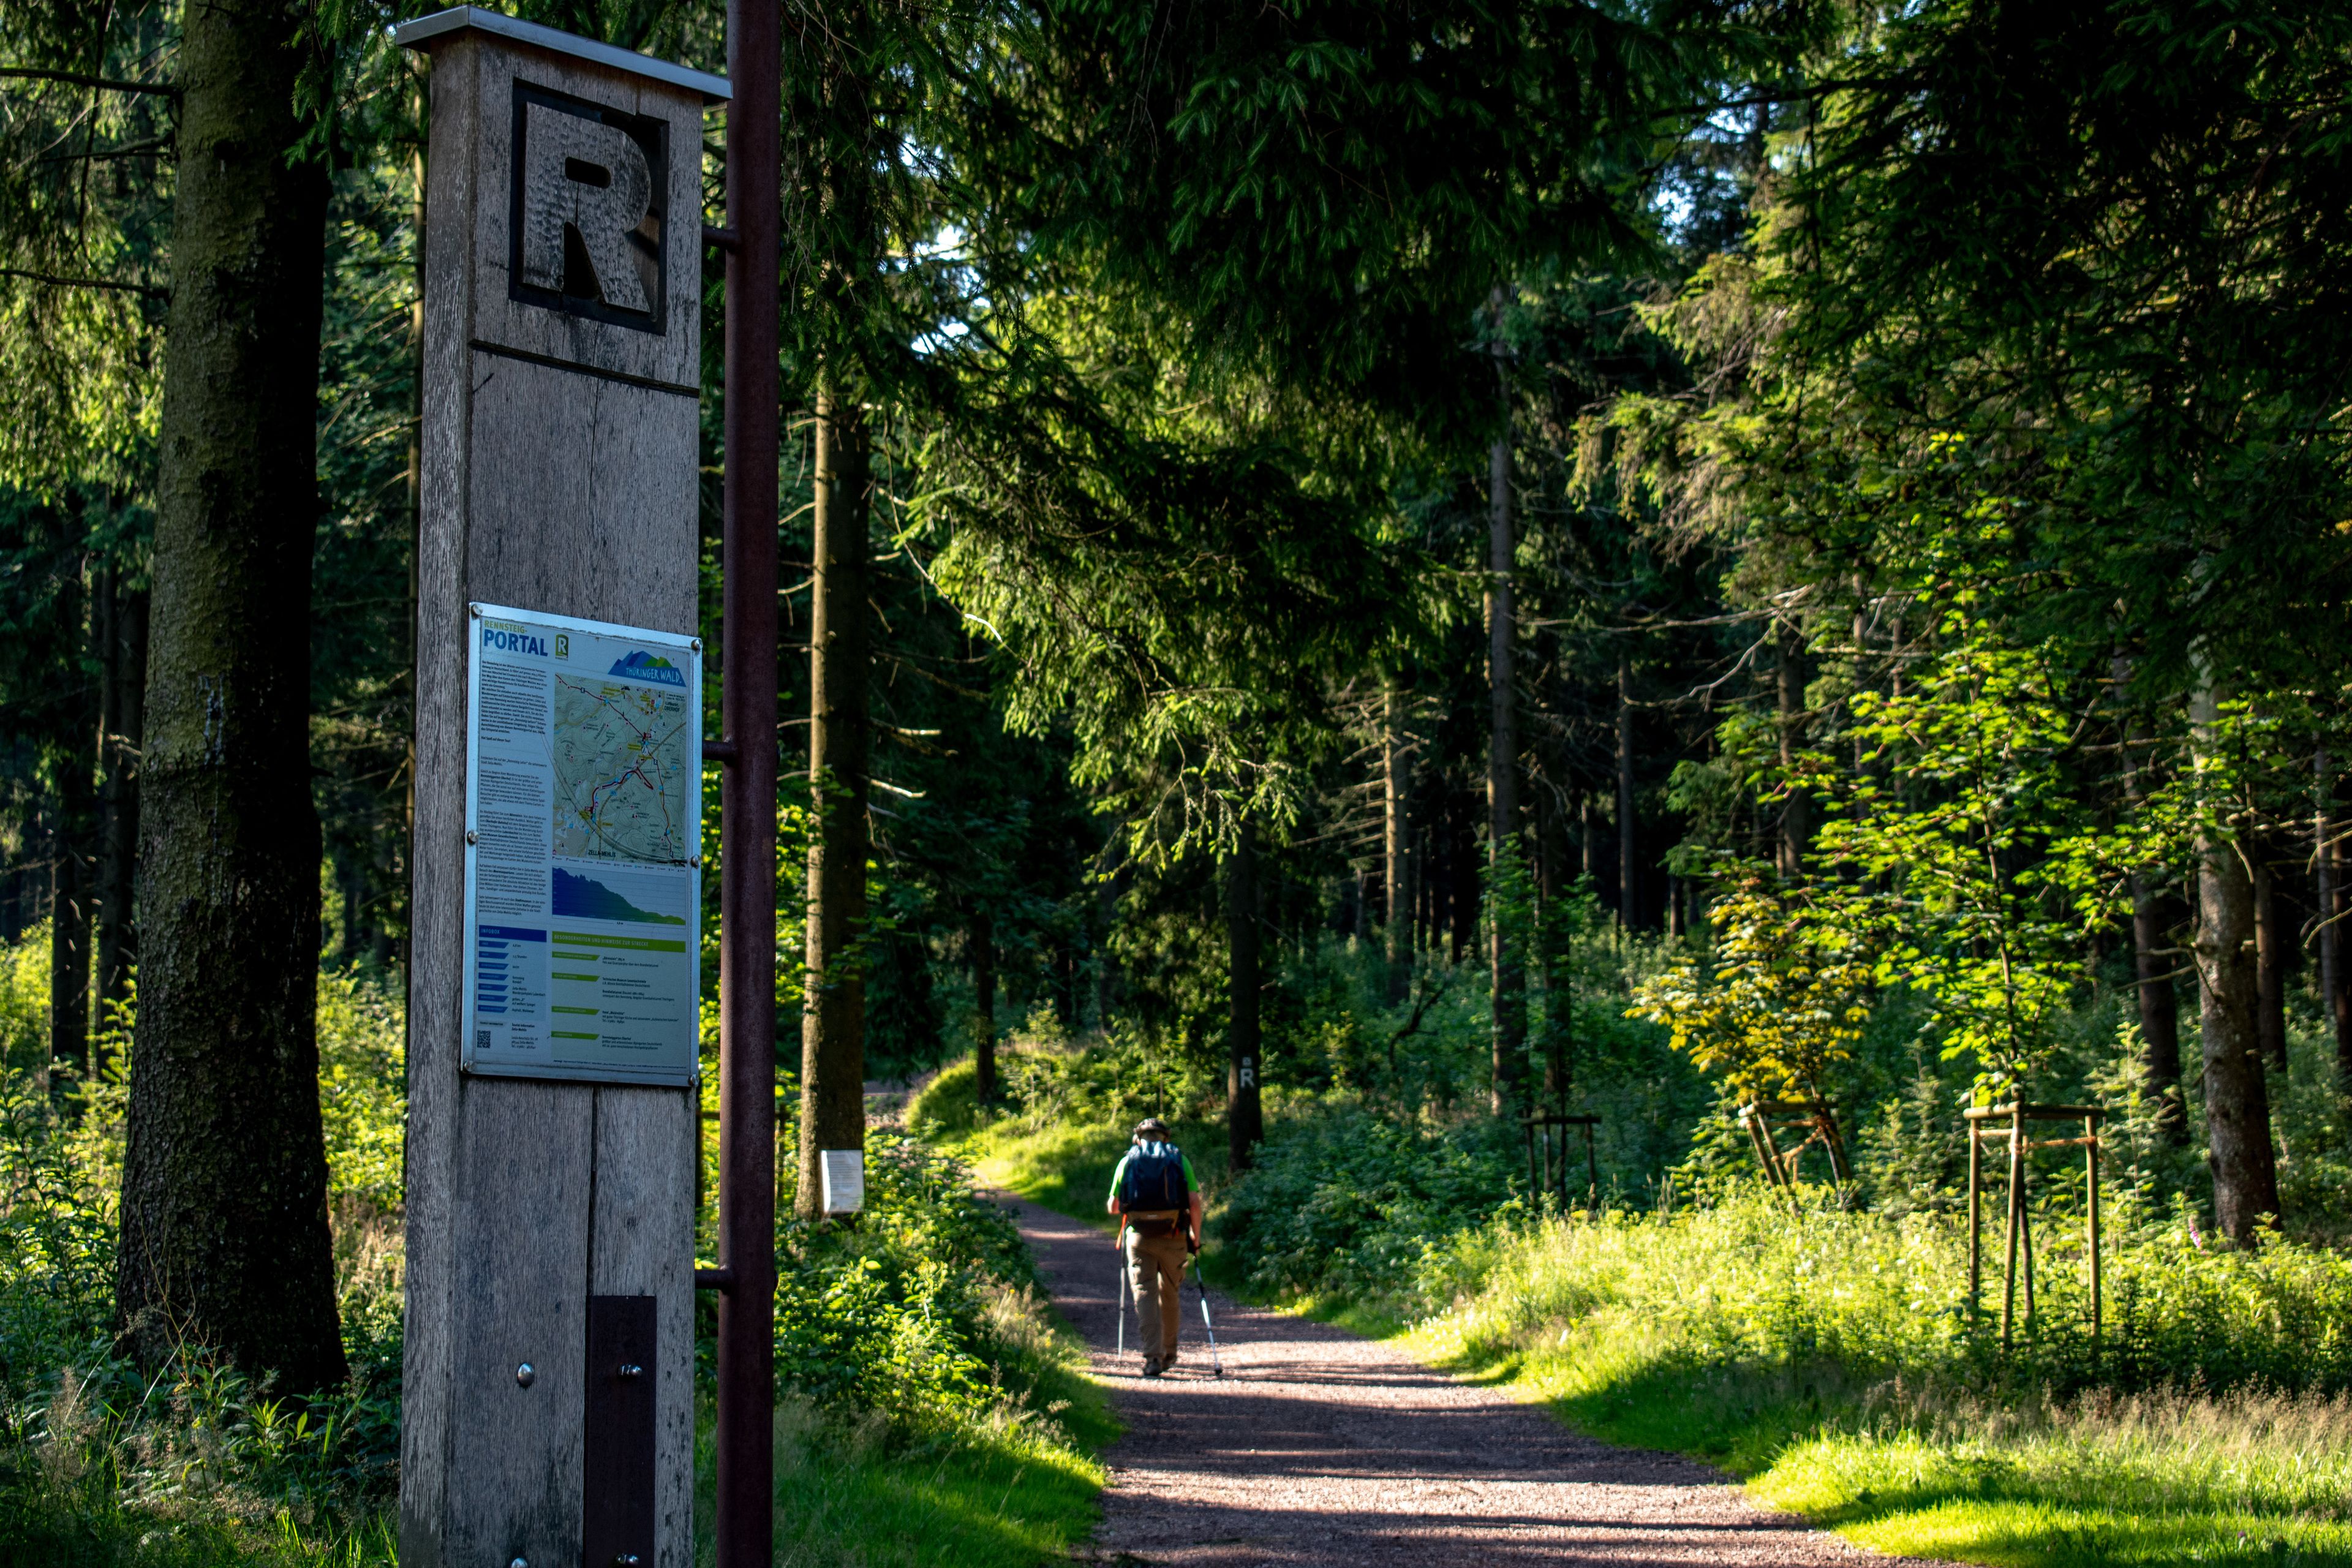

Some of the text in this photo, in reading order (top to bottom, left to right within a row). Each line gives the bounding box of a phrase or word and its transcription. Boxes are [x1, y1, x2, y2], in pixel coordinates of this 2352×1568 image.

[522, 102, 651, 313] R
[485, 620, 527, 635] RENNSTEIG-
[484, 628, 548, 657] PORTAL
[558, 637, 567, 653] R
[626, 666, 682, 684] THÜRINGER WALD.
[588, 849, 616, 858] ZELLA-MEHLIS
[1240, 1068, 1254, 1088] R
